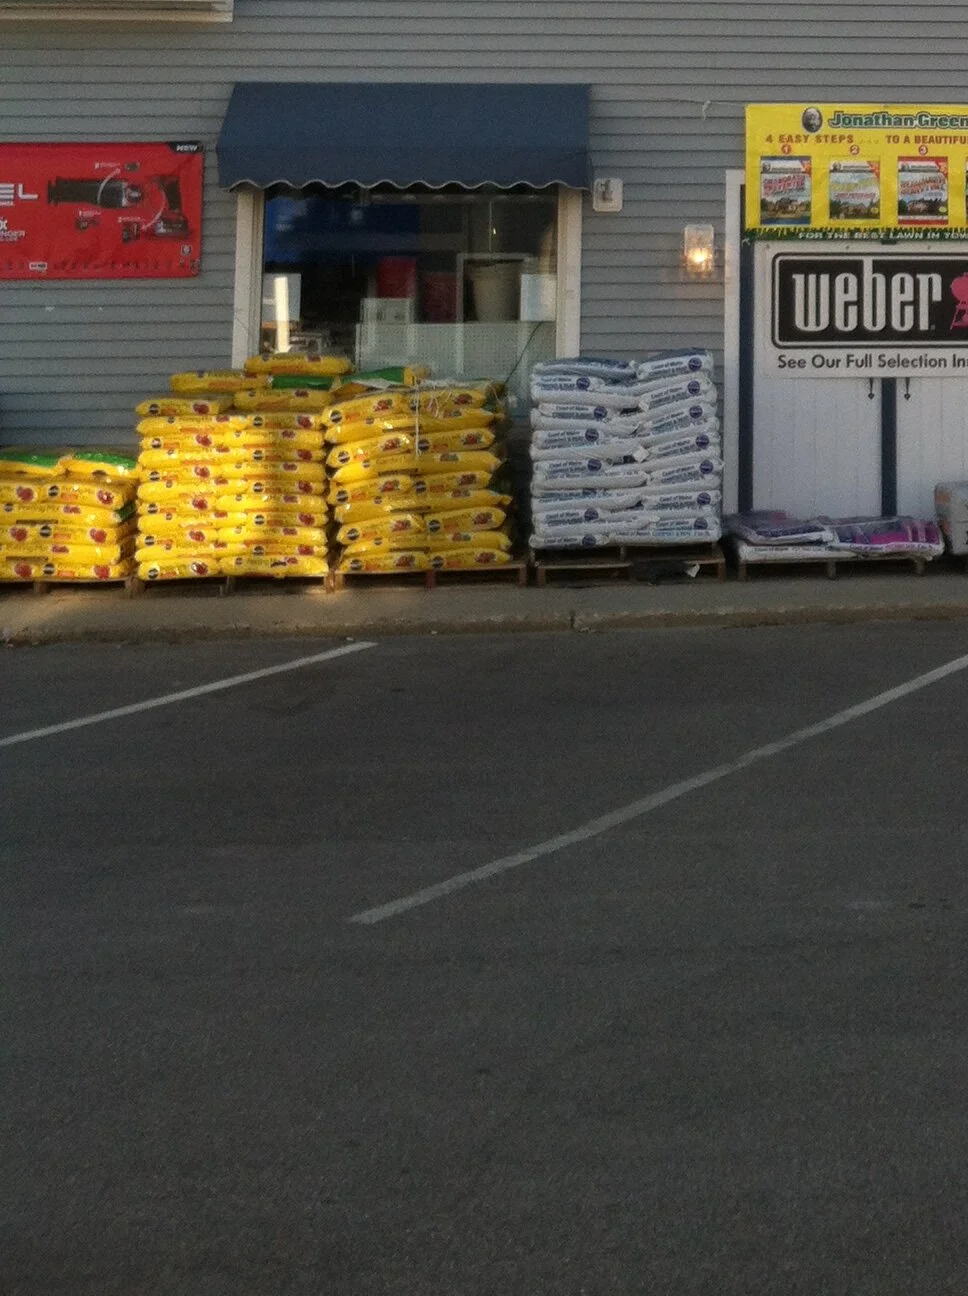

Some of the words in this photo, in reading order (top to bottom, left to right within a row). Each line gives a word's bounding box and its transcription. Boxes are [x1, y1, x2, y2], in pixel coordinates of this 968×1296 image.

[830, 111, 916, 128] Jonathan
[766, 135, 773, 143] 4
[779, 134, 810, 143] EASY
[815, 134, 854, 143] STEPS
[886, 135, 900, 144] TO
[903, 135, 911, 144] A
[799, 231, 823, 240] FOR
[827, 231, 850, 240] THE
[854, 231, 886, 240] BEST
[889, 231, 923, 240] LAWN
[927, 231, 940, 240] IN
[792, 260, 942, 332] weber
[777, 355, 807, 369] See
[811, 355, 841, 369] Our
[846, 354, 873, 369] Full
[878, 354, 948, 369] Selection
